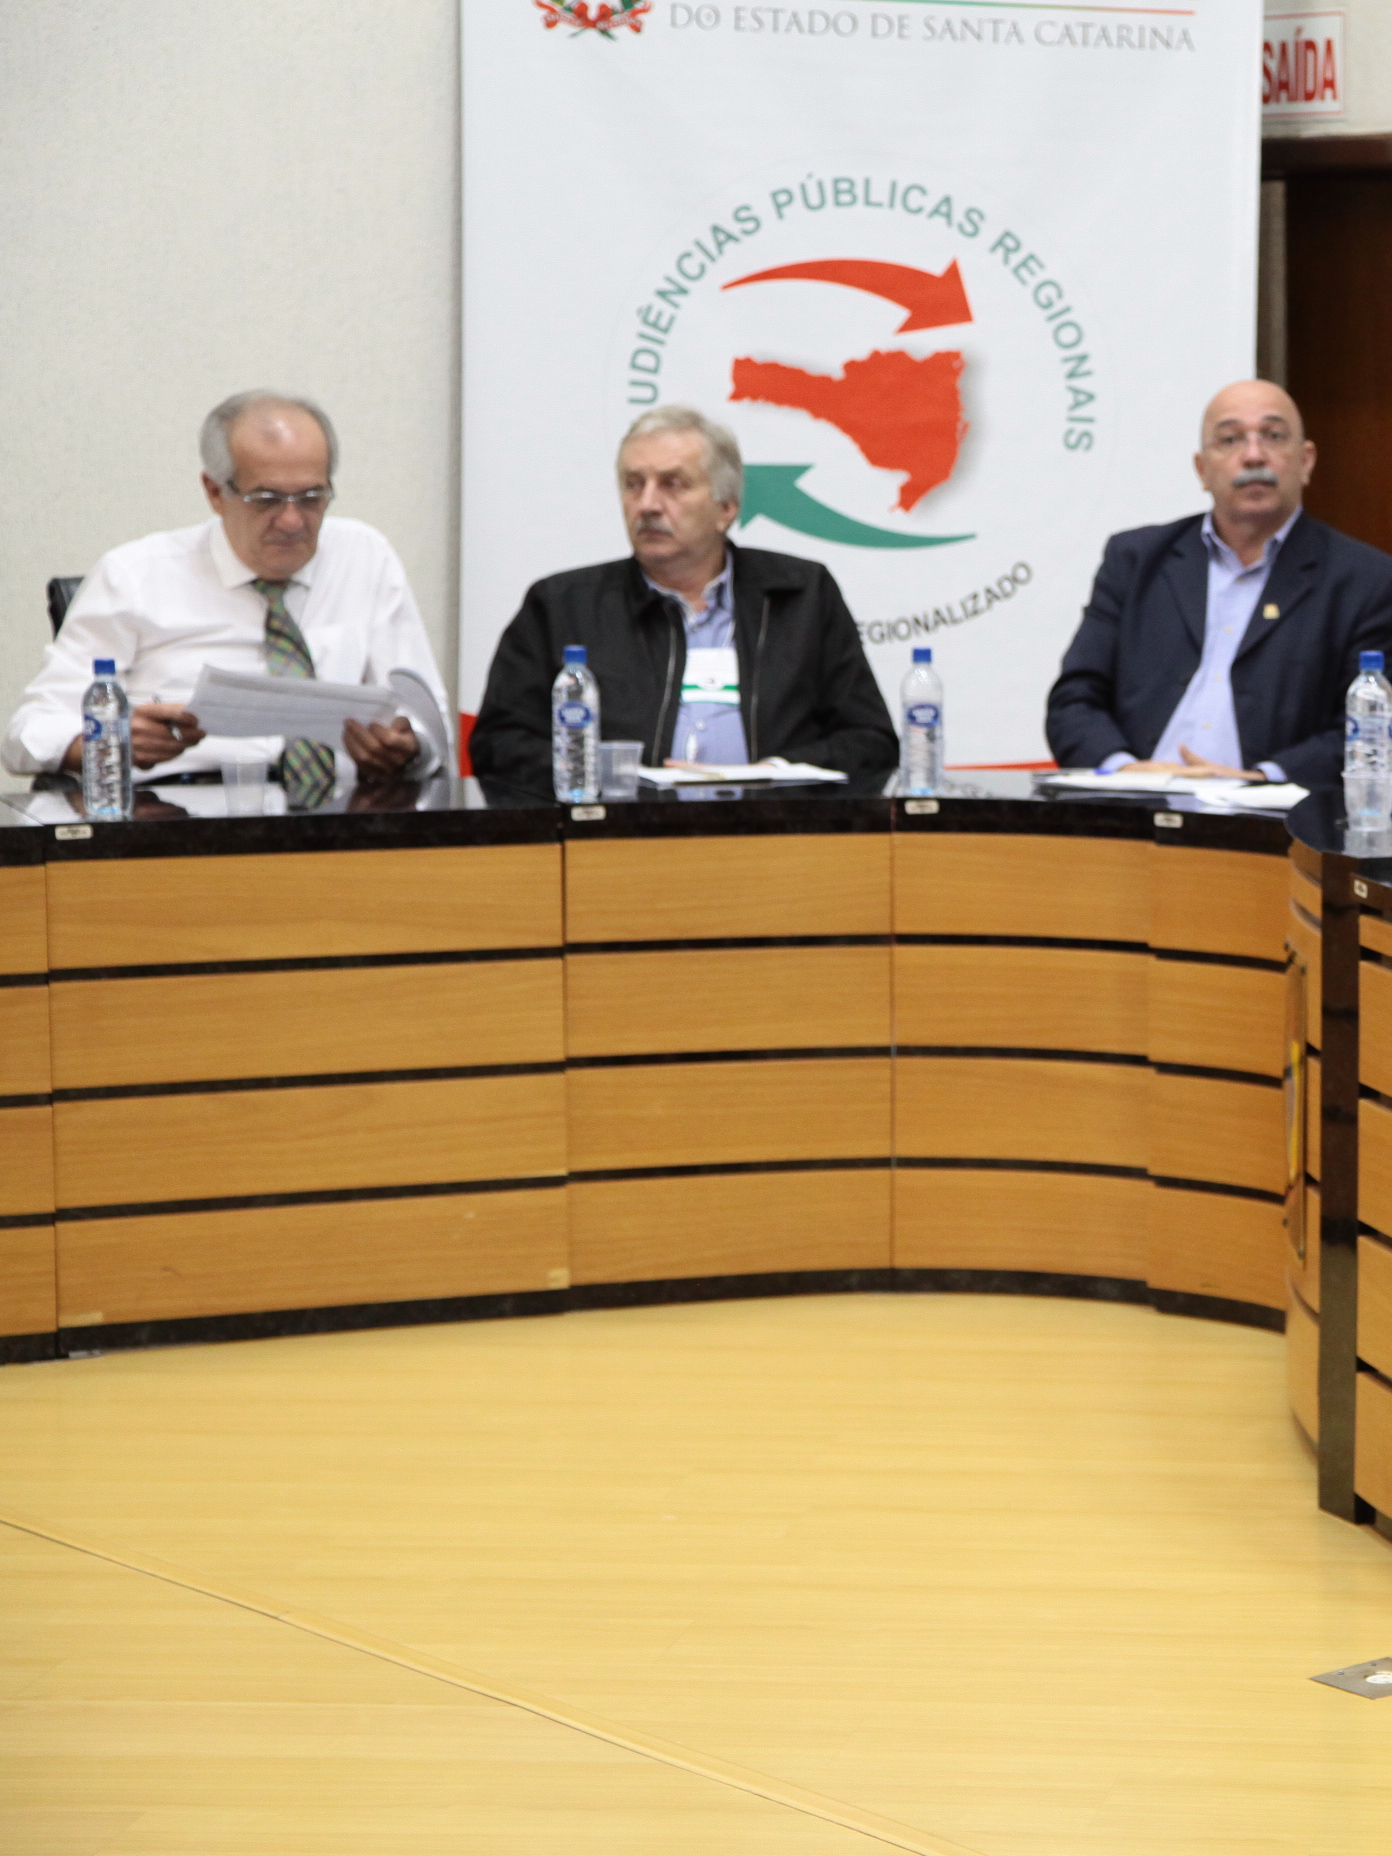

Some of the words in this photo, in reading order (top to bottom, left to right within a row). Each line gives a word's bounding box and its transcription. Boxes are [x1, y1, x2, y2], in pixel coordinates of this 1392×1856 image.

[670, 3, 721, 31] DO
[733, 6, 859, 38] ESTADO
[871, 11, 911, 40] DE
[922, 15, 1025, 45] SANTA
[1034, 20, 1196, 51] CATARINA
[1262, 26, 1337, 104] SAÍDA
[627, 203, 762, 406] UDIÊNCIAS
[770, 172, 986, 239] PÚBLICAS
[989, 229, 1097, 453] REGIONAIS
[857, 561, 1033, 645] GIONALIZADO
